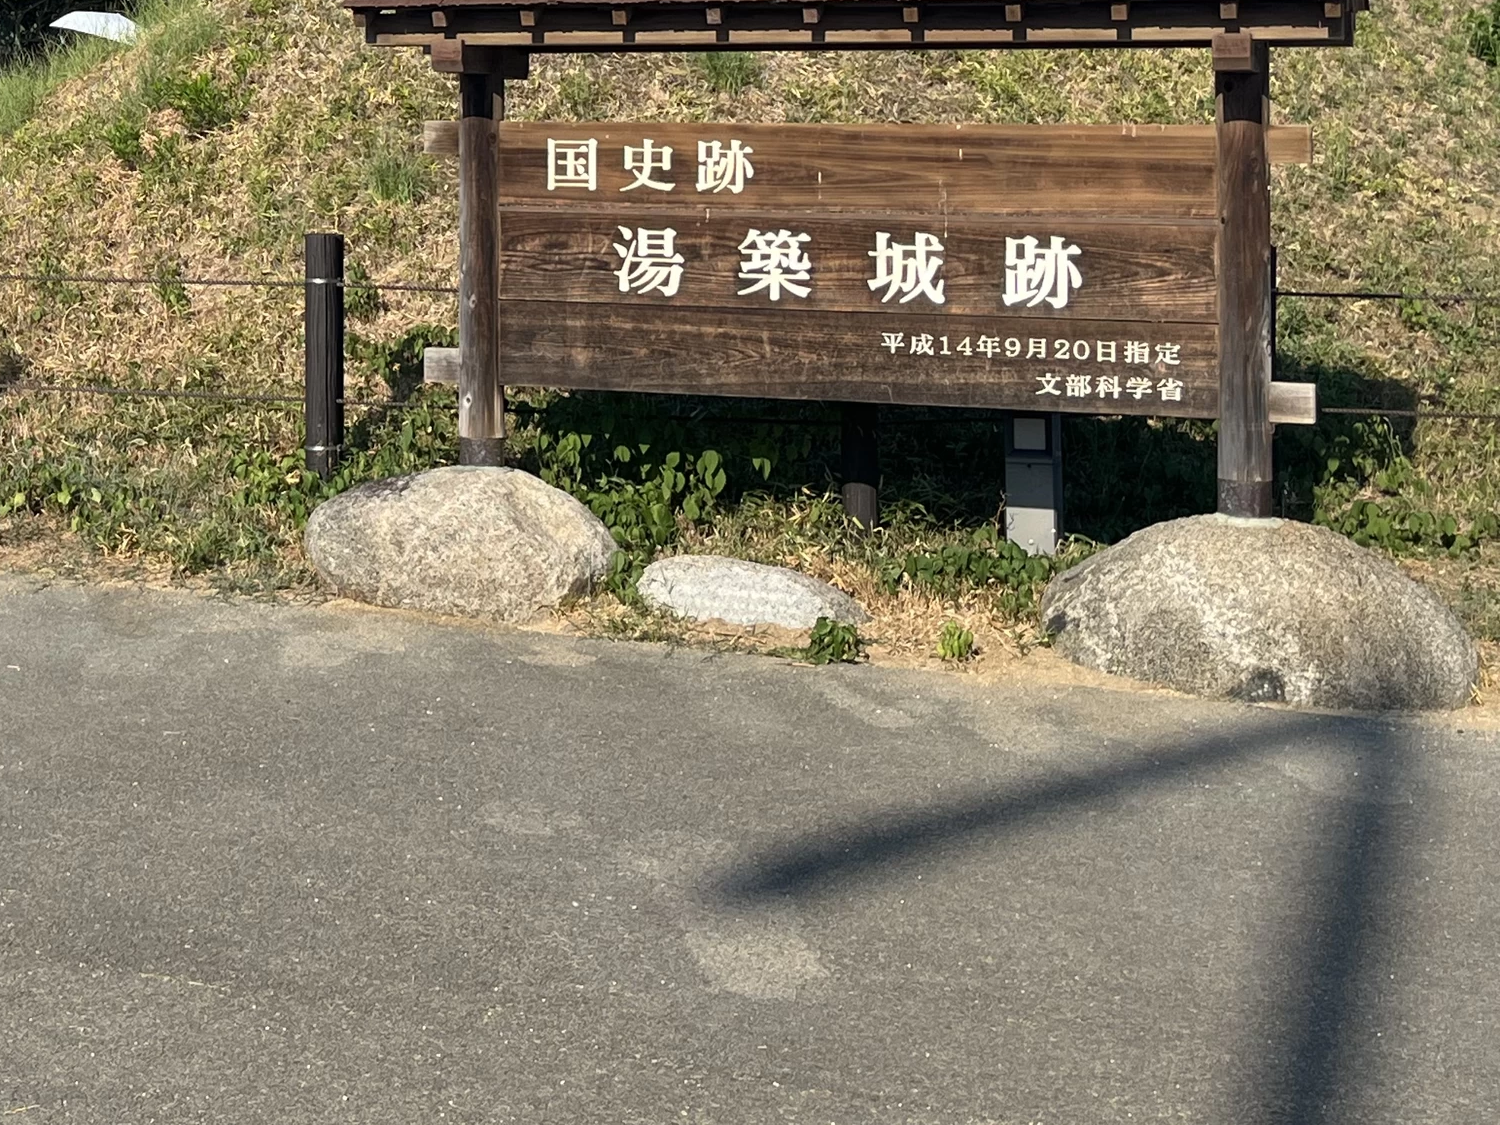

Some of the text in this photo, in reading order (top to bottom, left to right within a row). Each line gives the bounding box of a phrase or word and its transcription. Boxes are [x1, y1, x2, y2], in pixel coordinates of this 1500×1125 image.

[546, 138, 755, 194] 国史跡
[612, 224, 1083, 310] 湯築城跡
[880, 331, 1182, 367] 平成14年9月20日指定
[1035, 373, 1184, 402] 文部科学省
